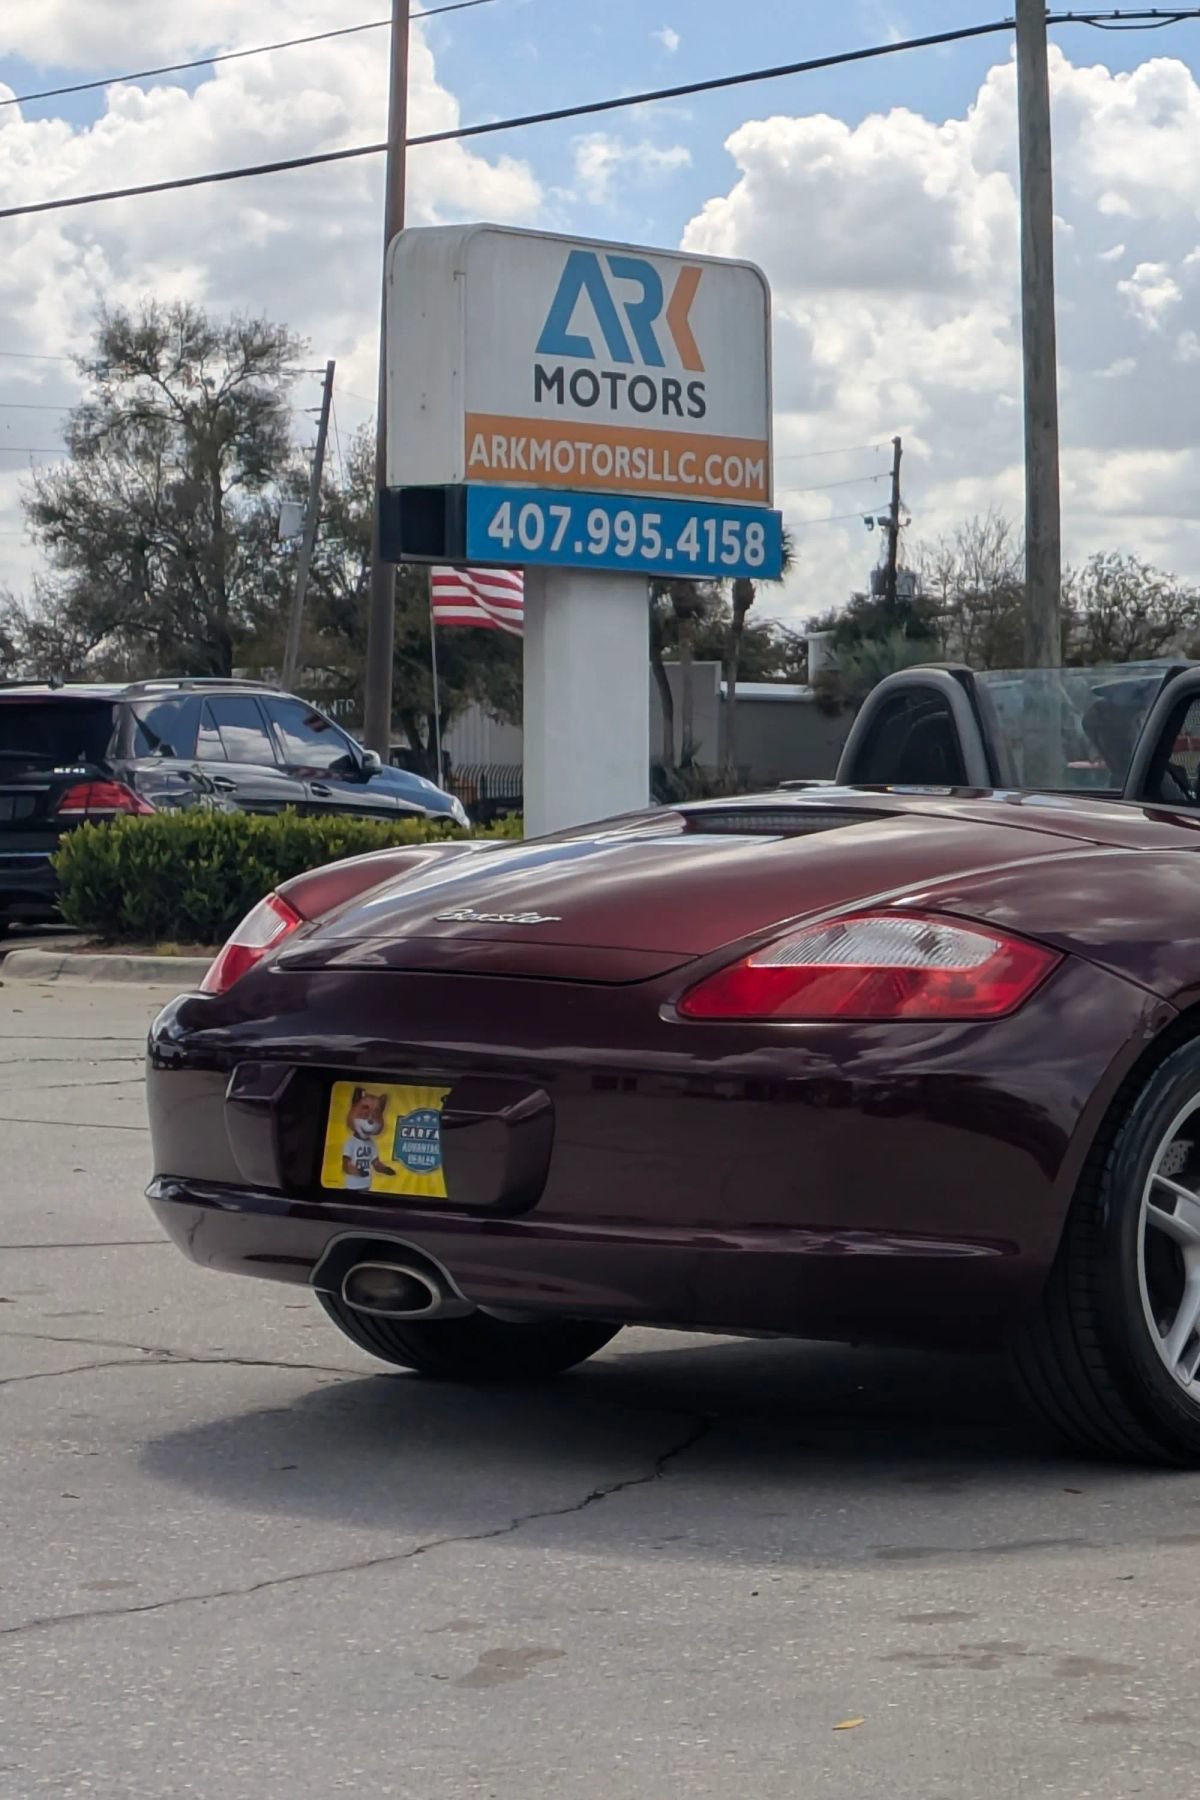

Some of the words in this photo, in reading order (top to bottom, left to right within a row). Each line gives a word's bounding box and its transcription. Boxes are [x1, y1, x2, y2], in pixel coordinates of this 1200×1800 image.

[535, 250, 705, 372] ARK
[534, 364, 706, 418] MOTORS
[469, 433, 764, 489] ARKMOTORSLLC.COM
[488, 502, 765, 566] 407.995.4158
